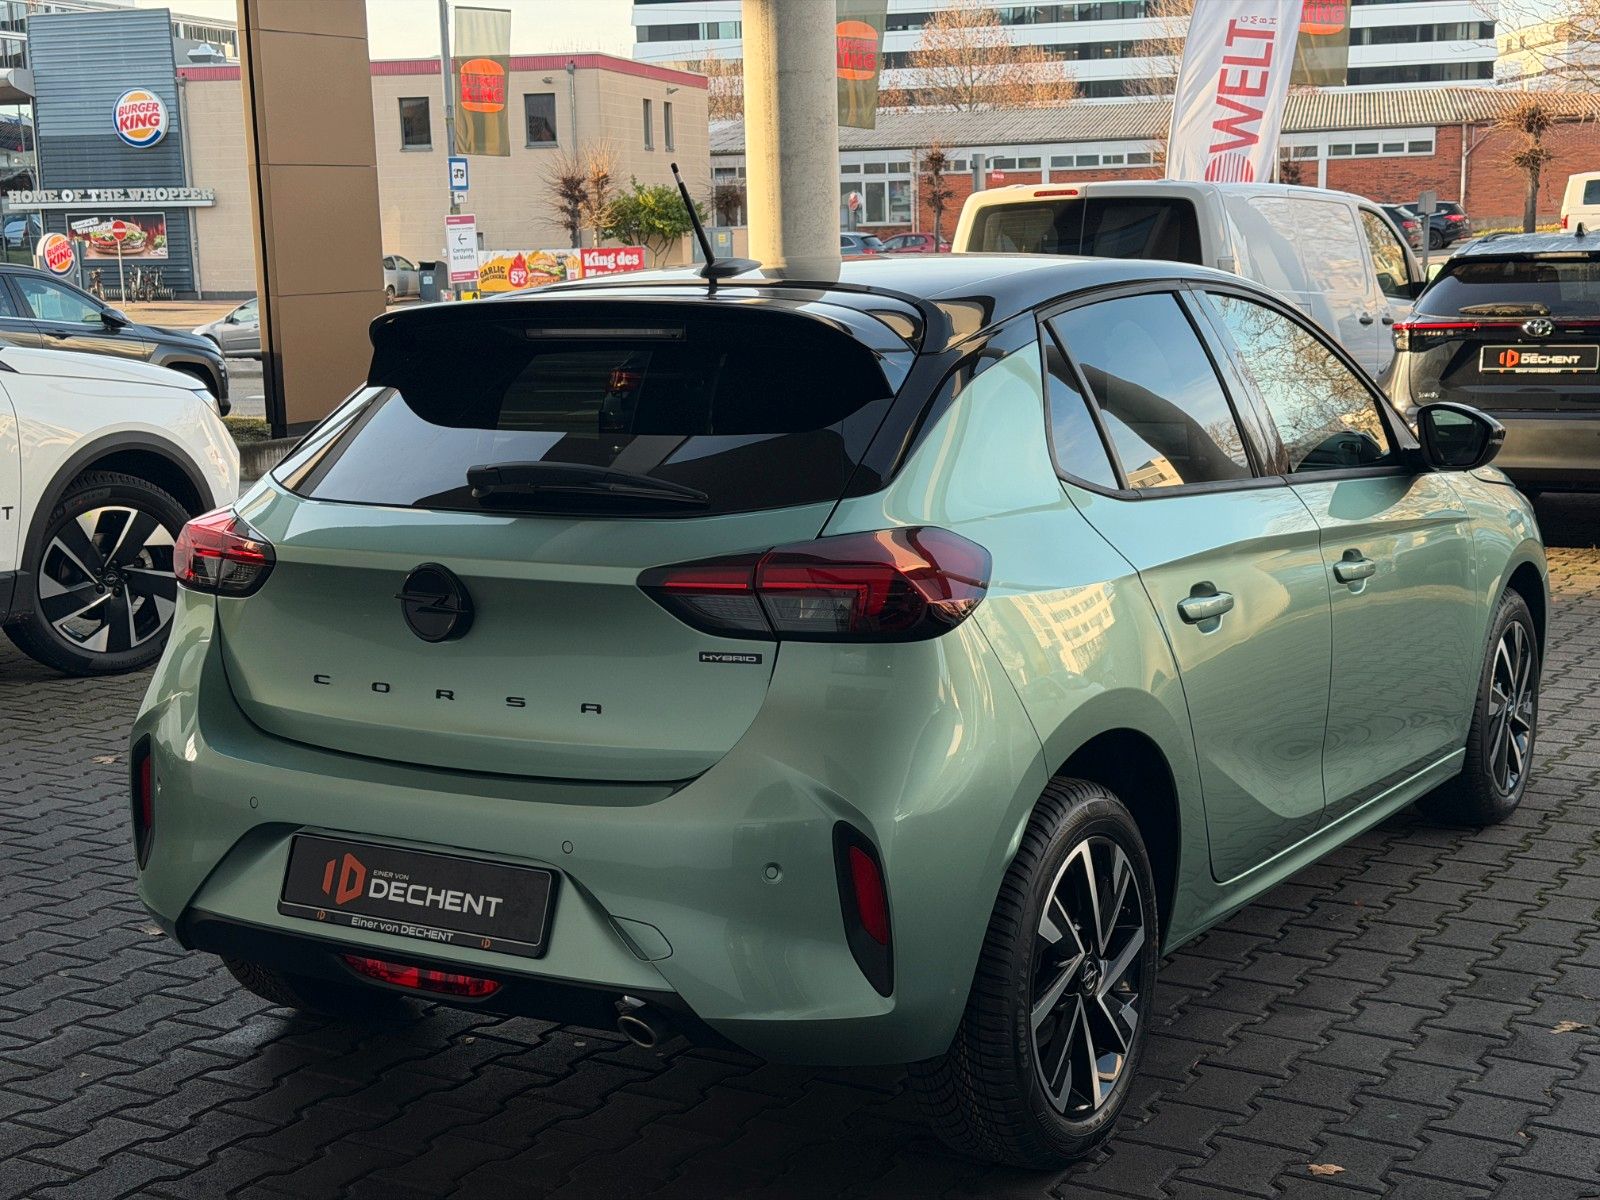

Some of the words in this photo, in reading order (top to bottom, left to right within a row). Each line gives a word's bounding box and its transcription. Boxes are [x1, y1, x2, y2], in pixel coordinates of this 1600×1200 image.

[1240, 15, 1278, 25] GMBH
[1209, 19, 1276, 153] WELT
[118, 102, 160, 117] BURGER
[119, 112, 161, 132] KING
[7, 189, 60, 204] HOME
[61, 189, 85, 203] OF
[85, 189, 123, 202] THE
[125, 187, 214, 202] WHOPPER
[49, 248, 72, 268] KING
[584, 252, 616, 269] King
[616, 251, 640, 266] des
[480, 265, 506, 278] GARLIC
[1520, 355, 1581, 364] DECHENT
[702, 654, 757, 662] HYBRID
[313, 673, 602, 715] CORSA
[373, 869, 394, 879] EINER
[394, 873, 410, 881] VON
[369, 878, 504, 917] DECHENT
[351, 916, 379, 930] Einer
[380, 922, 399, 934] von
[400, 925, 454, 942] DECHENT
